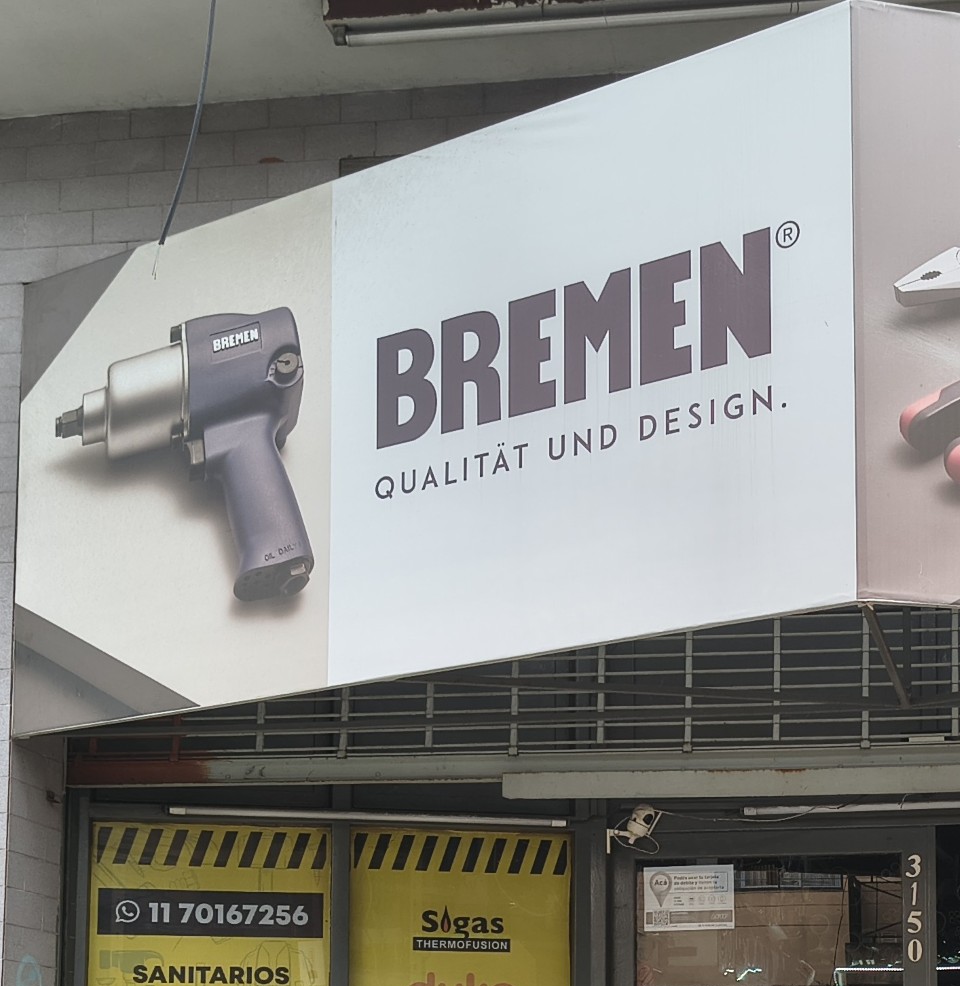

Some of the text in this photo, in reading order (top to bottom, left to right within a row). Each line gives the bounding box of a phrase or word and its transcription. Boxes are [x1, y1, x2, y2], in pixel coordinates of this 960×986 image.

[212, 328, 259, 353] BREMEN
[374, 383, 789, 501] QUALITÄT UND DESIGN.
[148, 902, 309, 927] 11 70167256
[416, 939, 508, 951] THERMOFUSION
[132, 963, 290, 986] SANITARIOS
